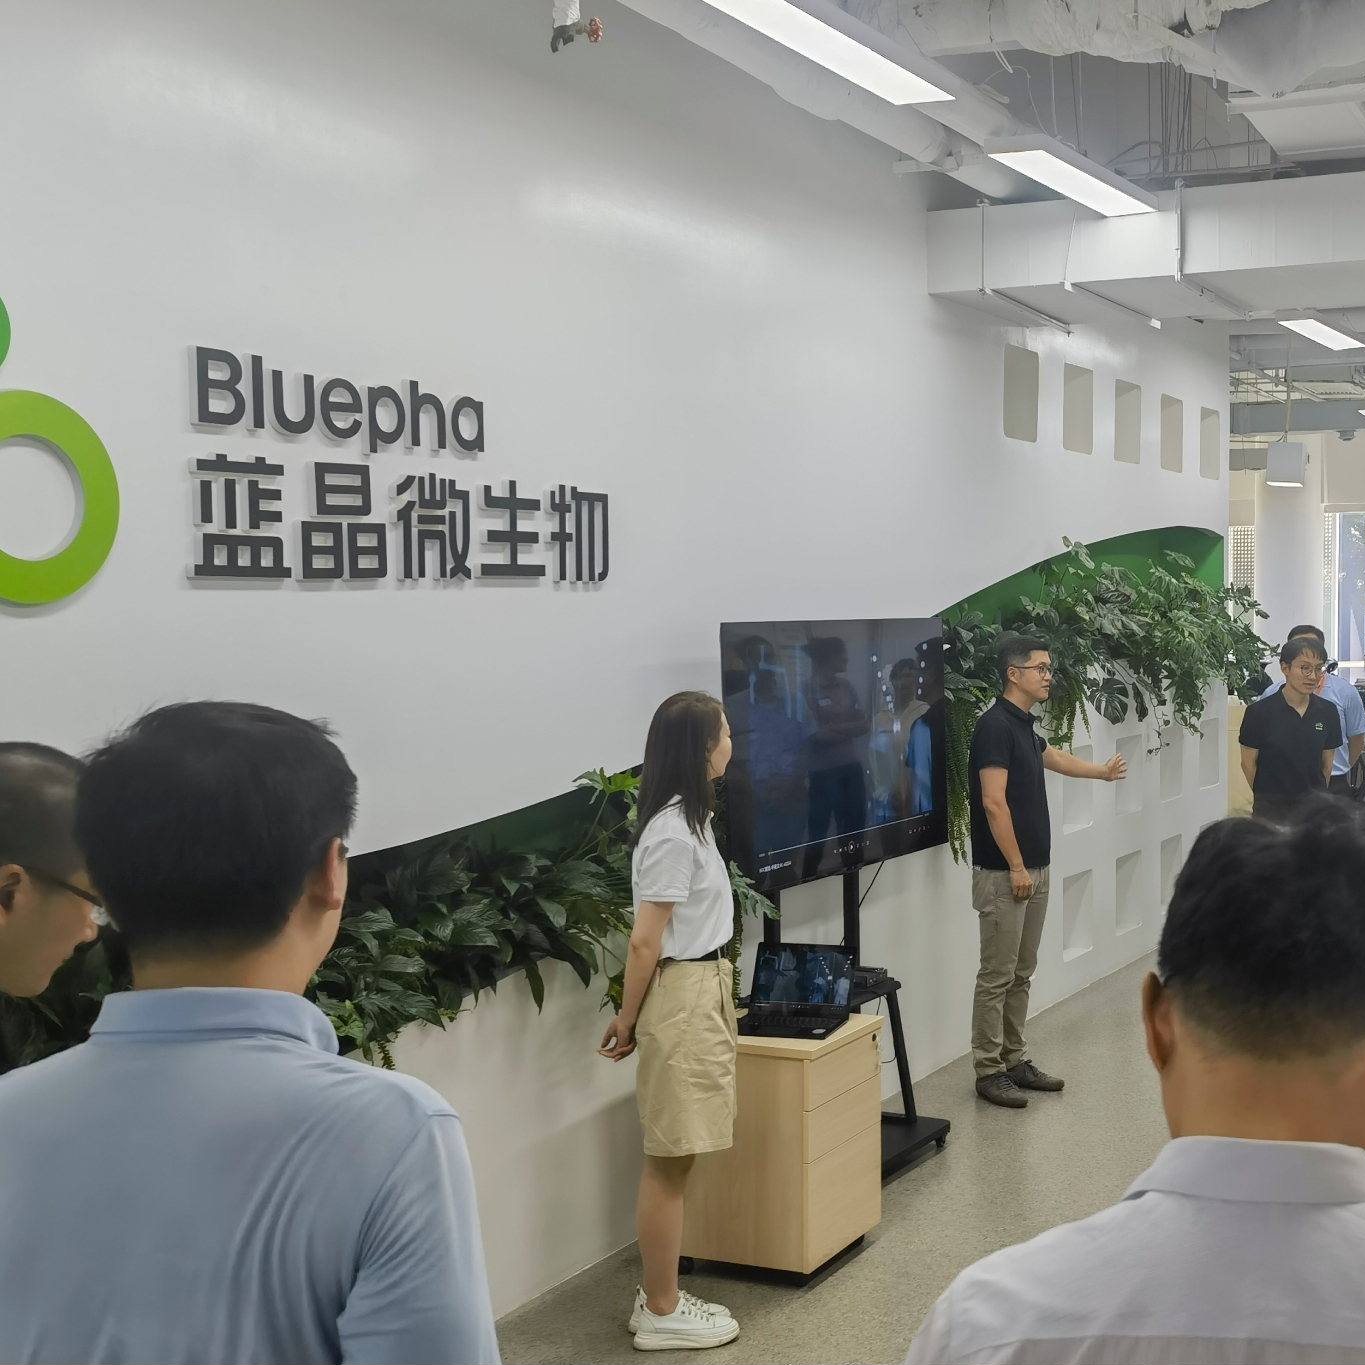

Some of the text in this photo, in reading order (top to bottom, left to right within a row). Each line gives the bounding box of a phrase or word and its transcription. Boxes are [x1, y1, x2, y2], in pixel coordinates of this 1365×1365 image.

[190, 345, 485, 454] Bluepha
[188, 453, 610, 587] 蓝晶微生物
